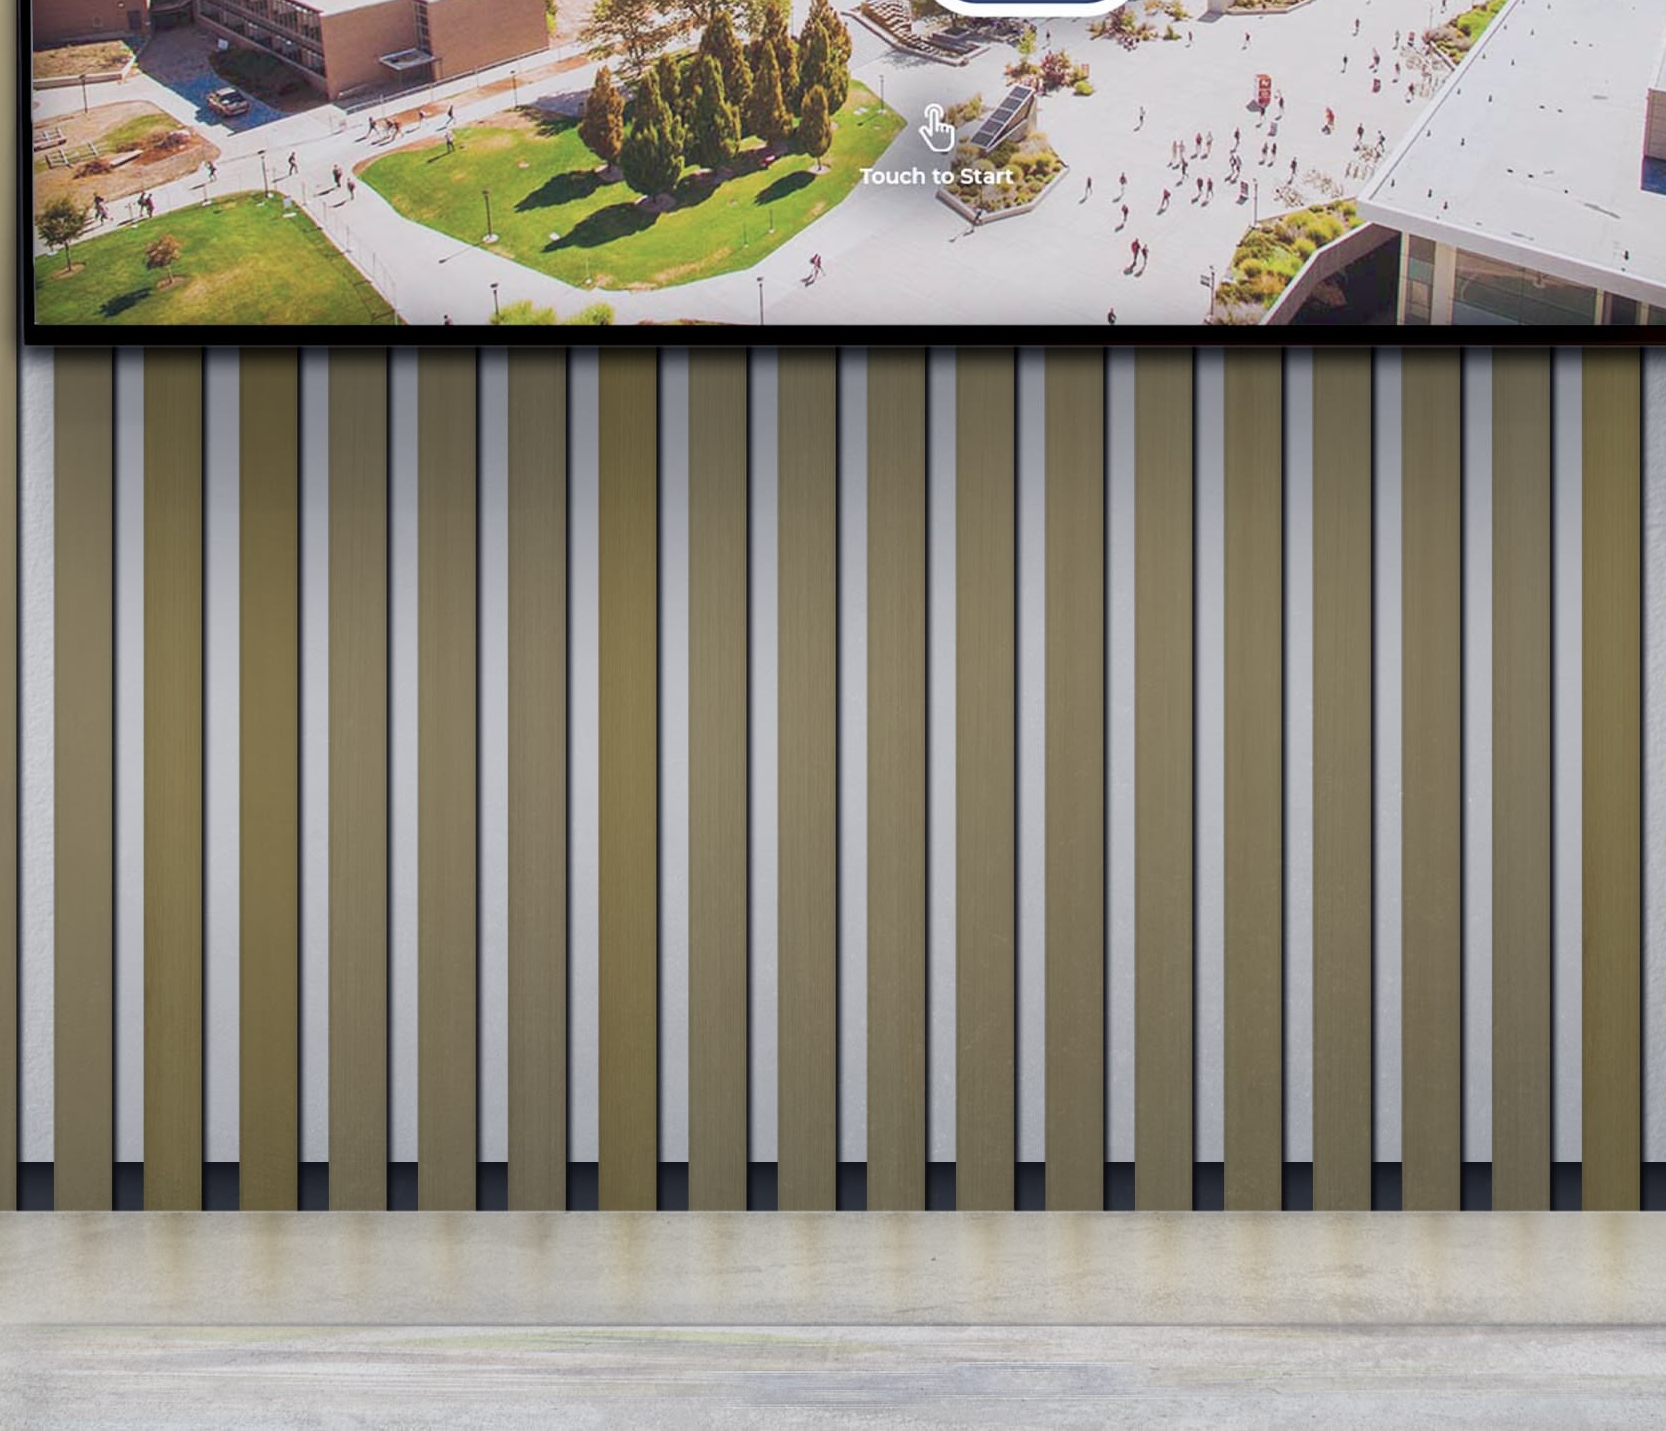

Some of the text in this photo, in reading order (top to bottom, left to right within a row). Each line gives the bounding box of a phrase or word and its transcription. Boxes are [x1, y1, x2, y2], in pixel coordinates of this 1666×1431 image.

[859, 167, 1014, 185] Touch to Start
